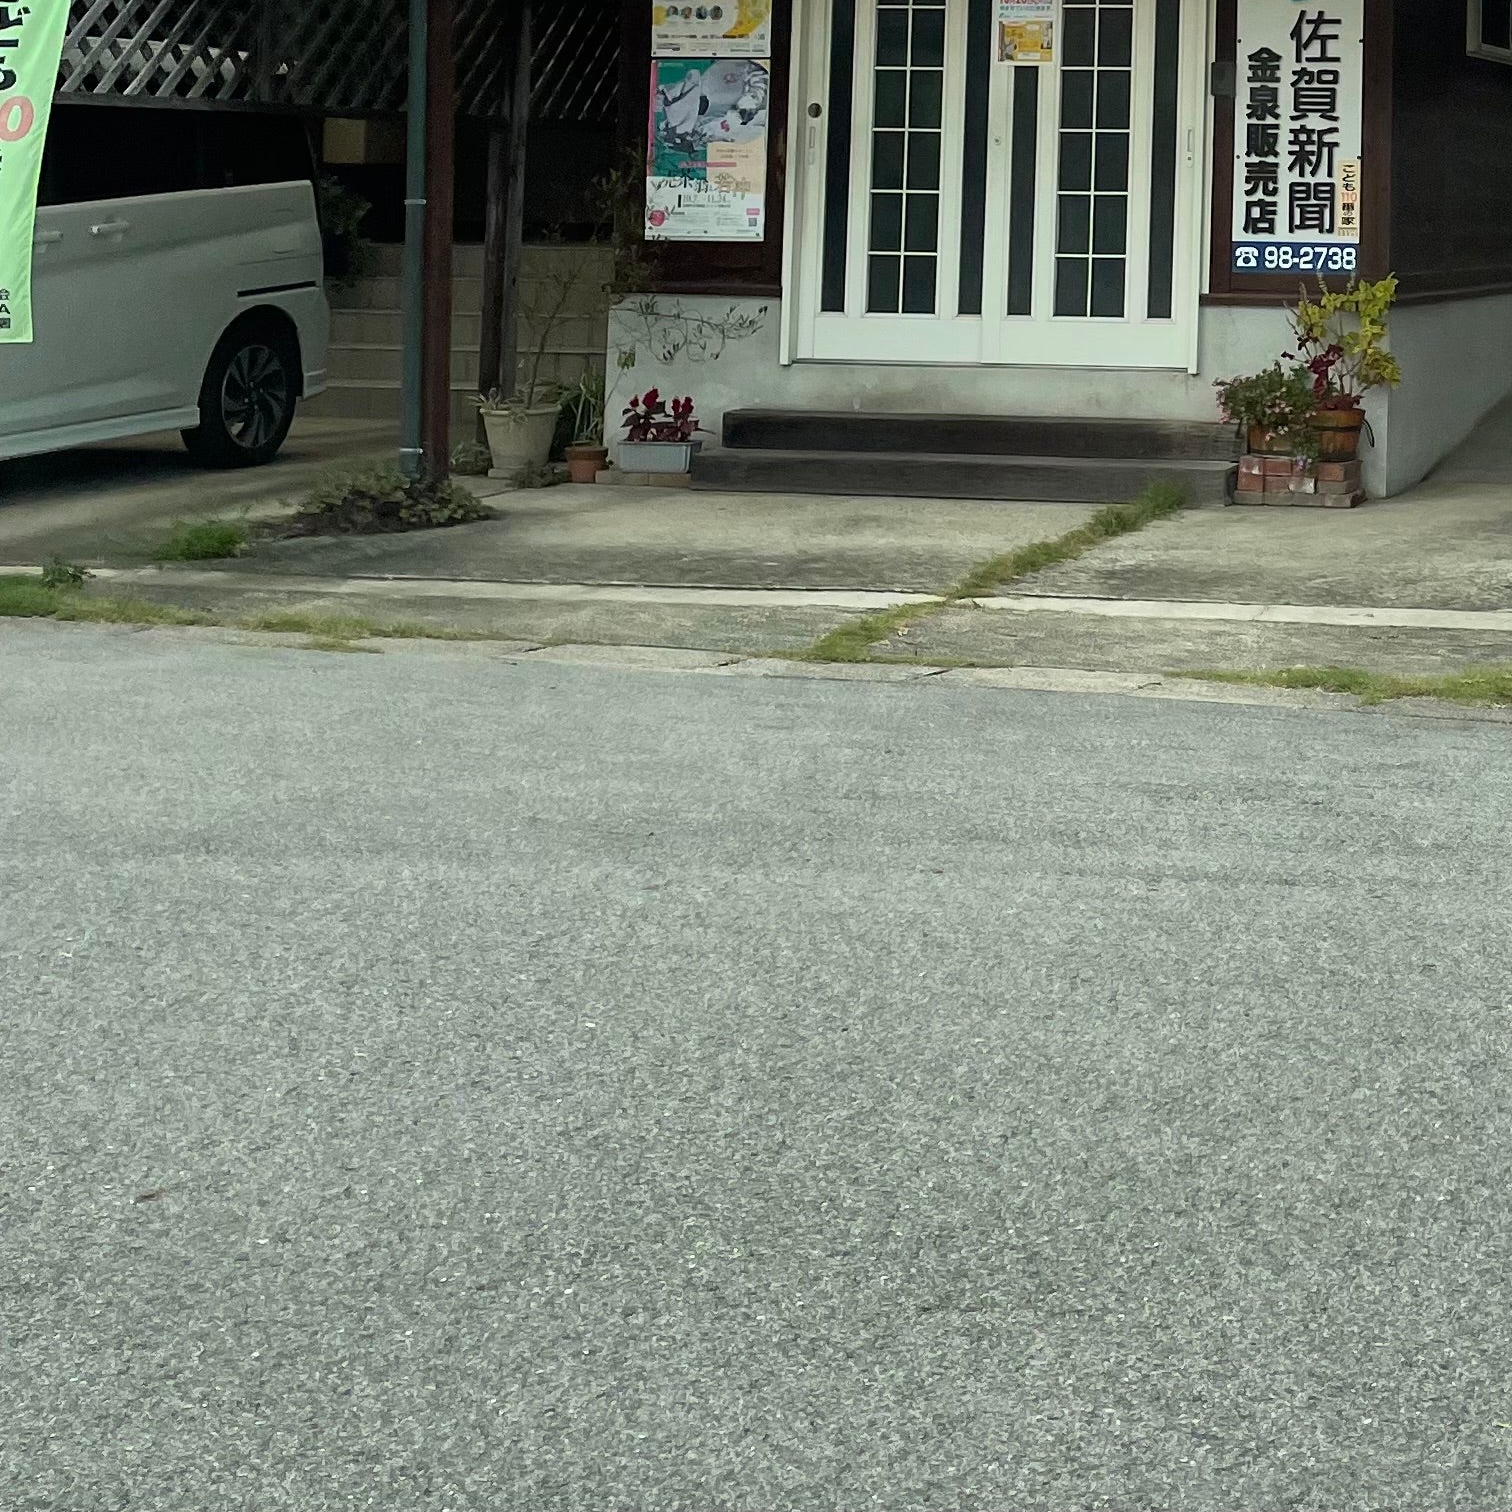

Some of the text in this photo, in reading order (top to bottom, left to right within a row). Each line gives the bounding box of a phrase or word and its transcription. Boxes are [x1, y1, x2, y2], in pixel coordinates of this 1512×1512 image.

[1243, 46, 1283, 235] 金泉販売店
[1288, 9, 1342, 235] 佐賀新聞
[1264, 245, 1357, 271] 98-2738
